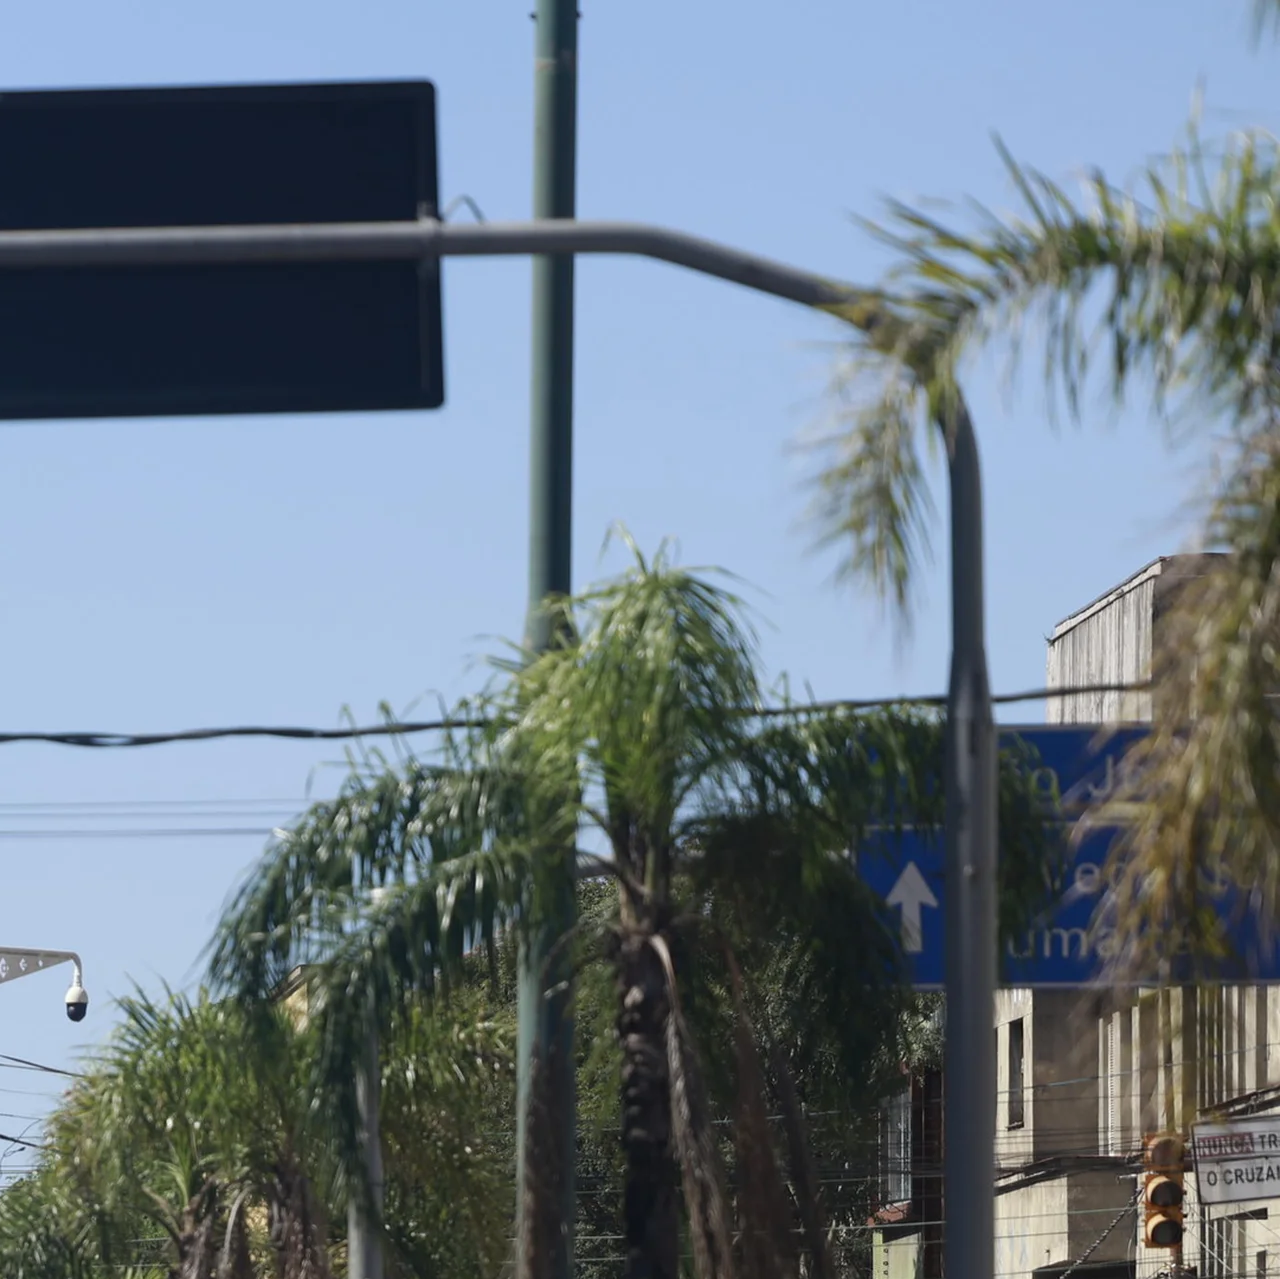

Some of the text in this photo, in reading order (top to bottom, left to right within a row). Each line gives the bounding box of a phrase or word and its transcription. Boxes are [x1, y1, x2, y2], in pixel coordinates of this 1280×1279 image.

[1199, 1133, 1280, 1157] NUNCA TR
[1206, 1165, 1280, 1187] O CRUZA
